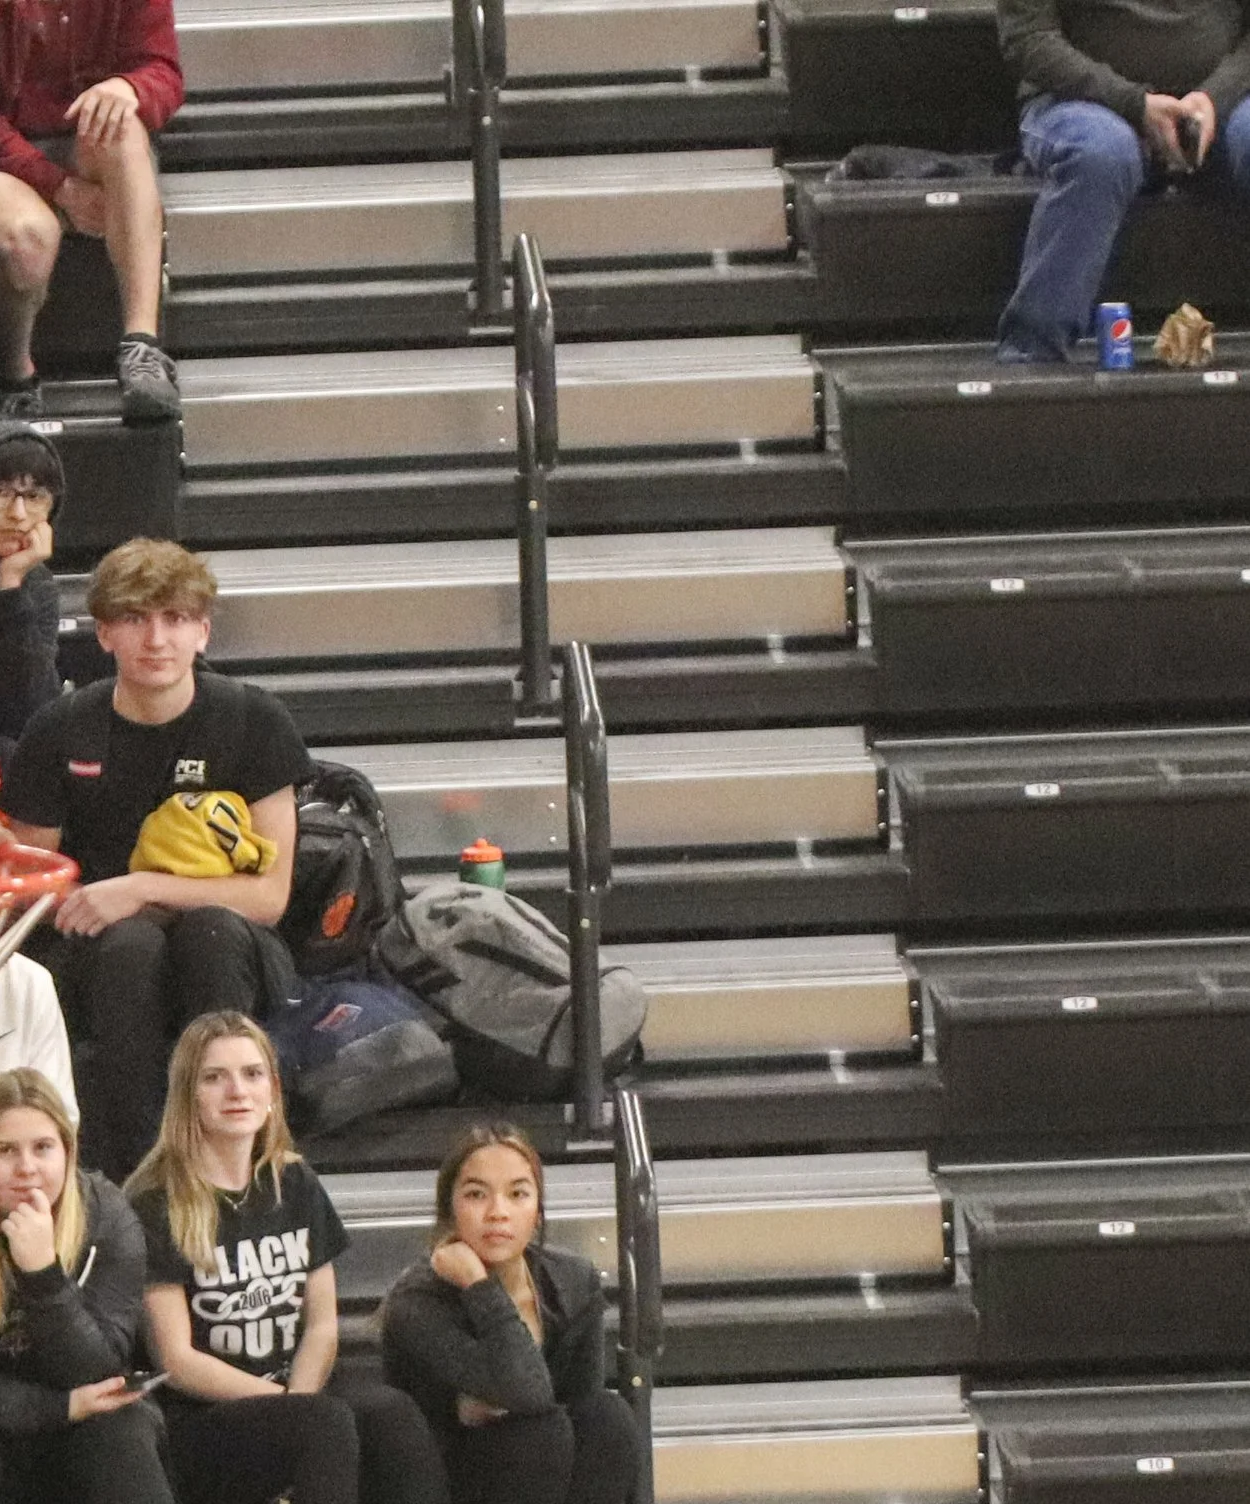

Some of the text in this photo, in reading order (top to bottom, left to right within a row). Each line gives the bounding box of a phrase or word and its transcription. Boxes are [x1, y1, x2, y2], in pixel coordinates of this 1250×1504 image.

[936, 192, 948, 203] 12
[1036, 784, 1051, 795] 12
[1072, 998, 1087, 1009] 12
[1110, 1222, 1125, 1233] 12
[209, 1312, 300, 1358] OUT
[1149, 1457, 1164, 1469] 10
